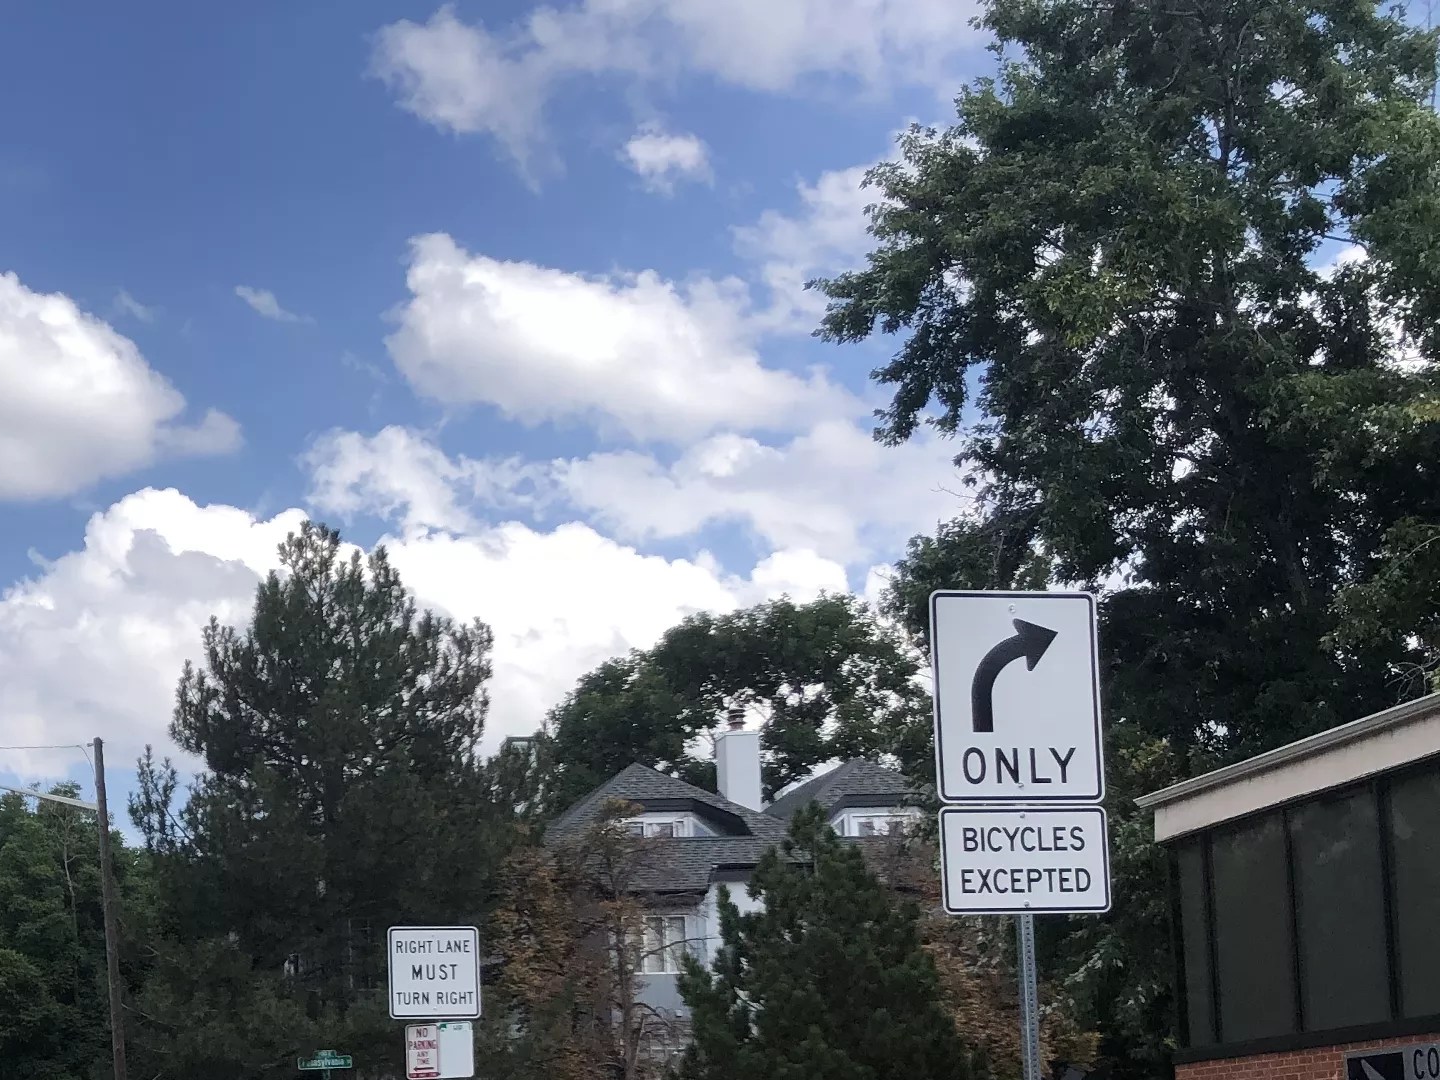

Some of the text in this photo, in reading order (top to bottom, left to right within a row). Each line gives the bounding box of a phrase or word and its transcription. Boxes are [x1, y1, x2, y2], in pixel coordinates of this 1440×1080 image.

[962, 747, 1077, 784] ONLY
[962, 826, 1086, 852] BICYCLES
[960, 868, 1092, 894] EXCEPTED
[395, 940, 471, 954] RIGHT LANE
[411, 964, 458, 980] MUST
[395, 991, 474, 1005] TURN RIGHT
[416, 1028, 429, 1038] NO
[408, 1040, 437, 1050] PARKING
